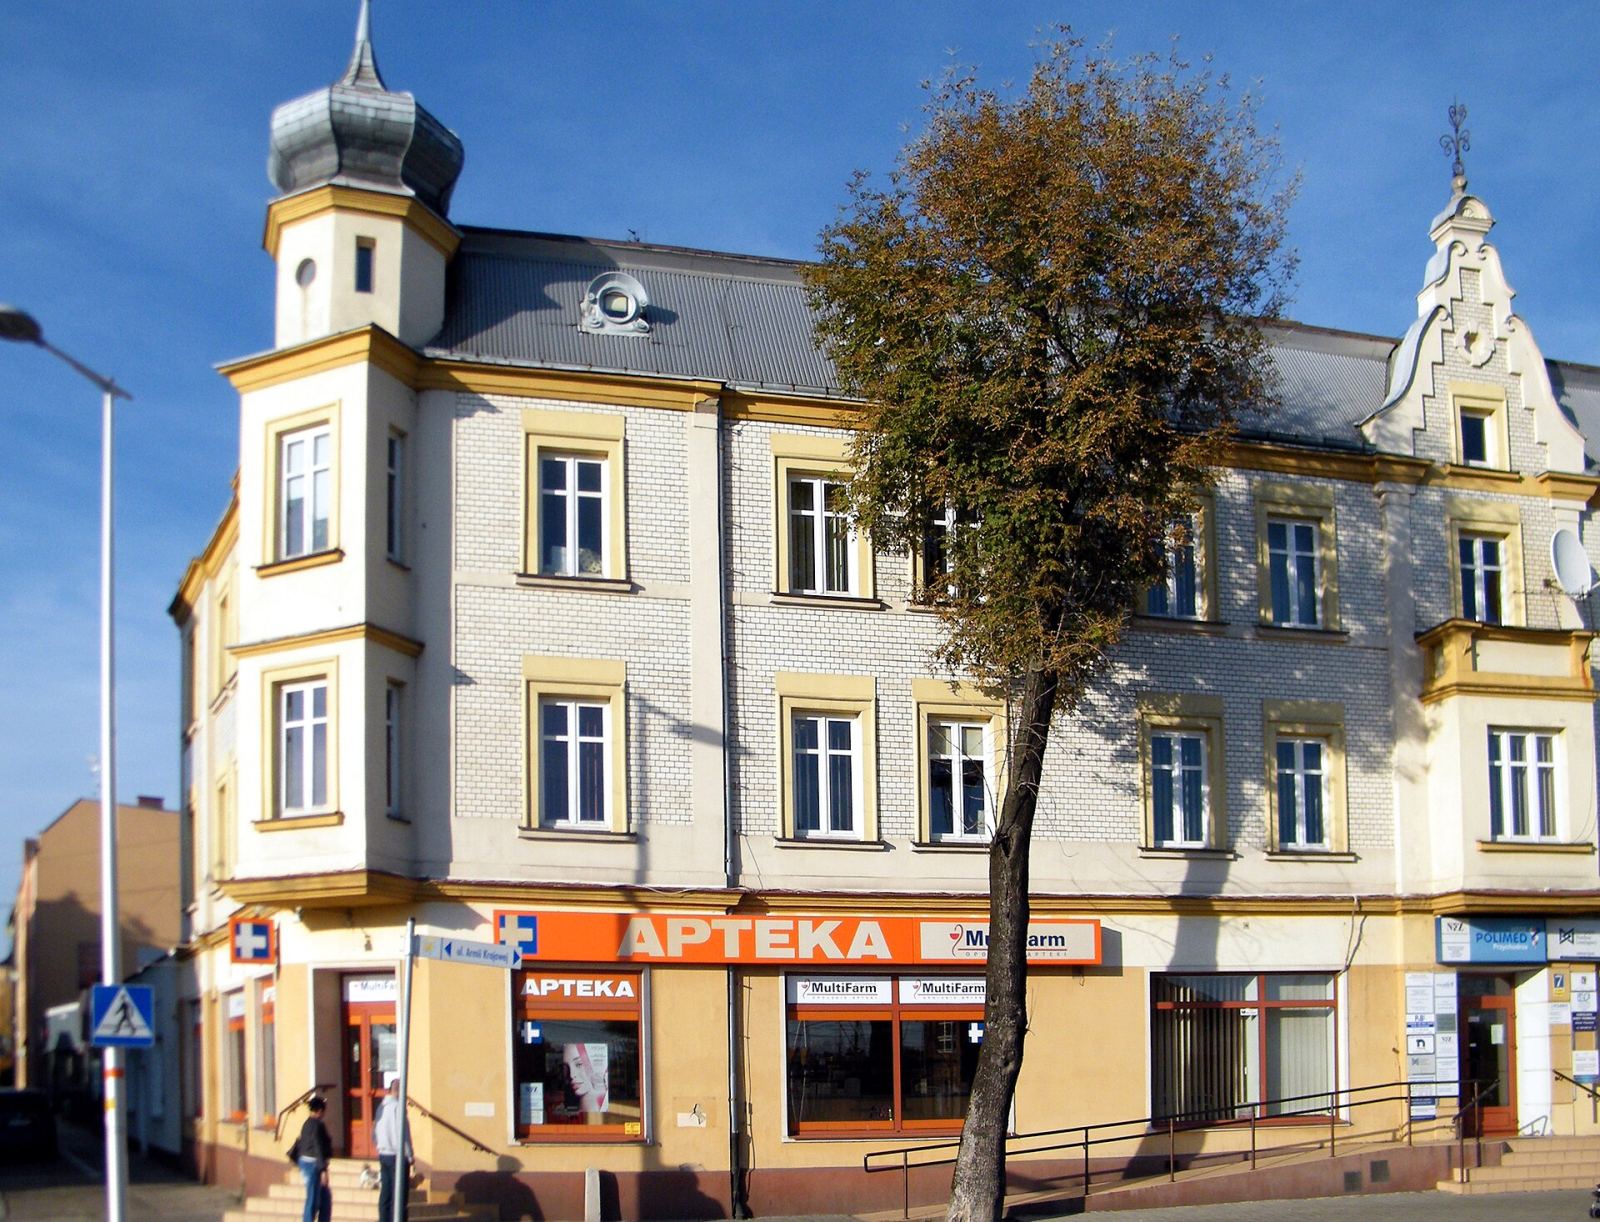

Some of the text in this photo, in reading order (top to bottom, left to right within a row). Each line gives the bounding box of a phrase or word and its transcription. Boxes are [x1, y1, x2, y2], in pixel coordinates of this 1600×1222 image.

[617, 918, 893, 960] APTEKA
[1476, 932, 1528, 944] POLIMED
[811, 982, 877, 993] MultiFarm
[922, 982, 986, 993] MultiFarm
[1554, 975, 1563, 988] 7
[520, 978, 635, 998] APTEKA
